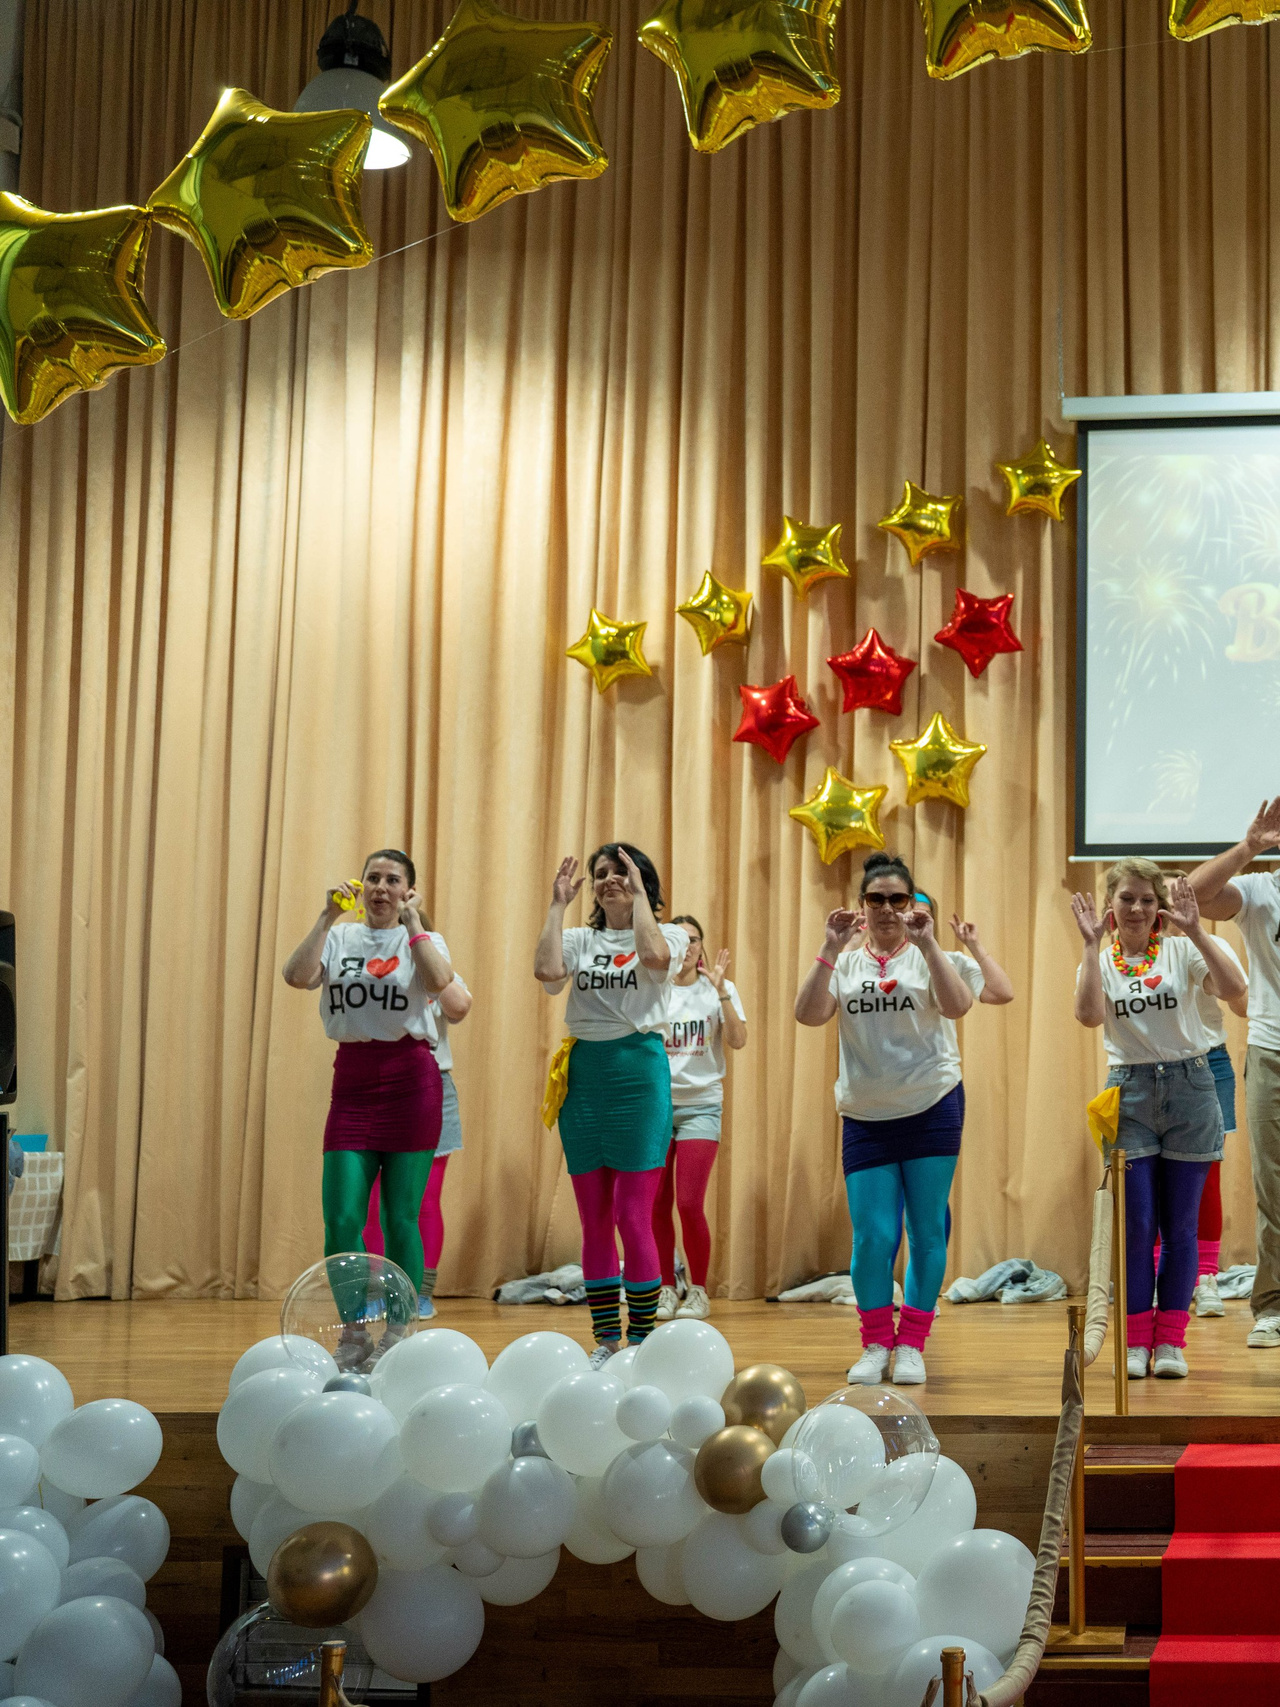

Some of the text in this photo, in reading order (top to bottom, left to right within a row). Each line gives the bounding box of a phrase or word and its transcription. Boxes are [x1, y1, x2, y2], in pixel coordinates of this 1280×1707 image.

[339, 956, 365, 979] Я
[589, 953, 612, 970] Я
[576, 968, 639, 991] СЫНА
[861, 980, 876, 994] Я
[1128, 979, 1141, 995] Я
[328, 982, 409, 1016] ДОЧЬ
[846, 995, 916, 1015] СЫНА
[1114, 994, 1178, 1020] ДОЧЬ
[665, 1020, 705, 1048] СТРА
